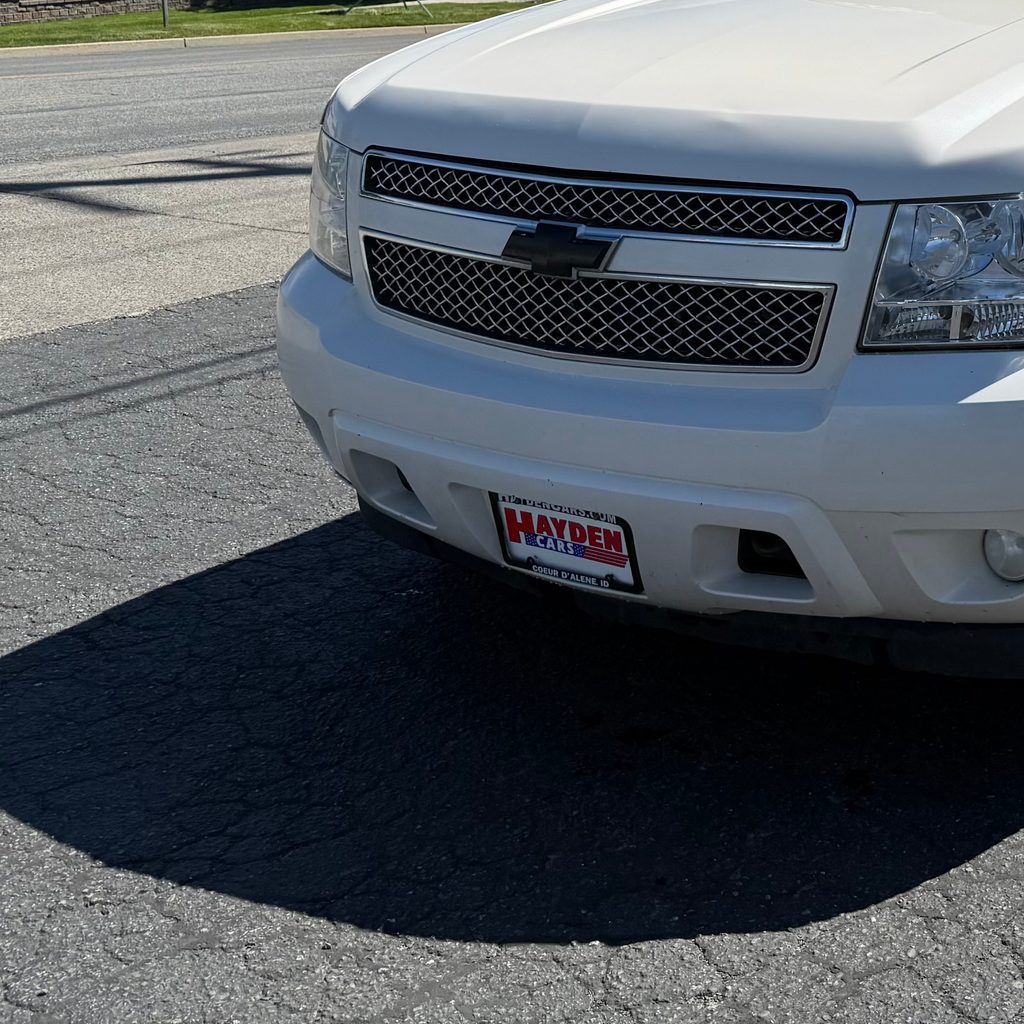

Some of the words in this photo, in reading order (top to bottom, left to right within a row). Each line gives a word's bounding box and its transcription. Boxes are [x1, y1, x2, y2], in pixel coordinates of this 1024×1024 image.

[504, 507, 623, 553] HAYDEN
[535, 534, 575, 555] CARS
[532, 564, 559, 577] COEUR
[600, 579, 610, 588] ID
